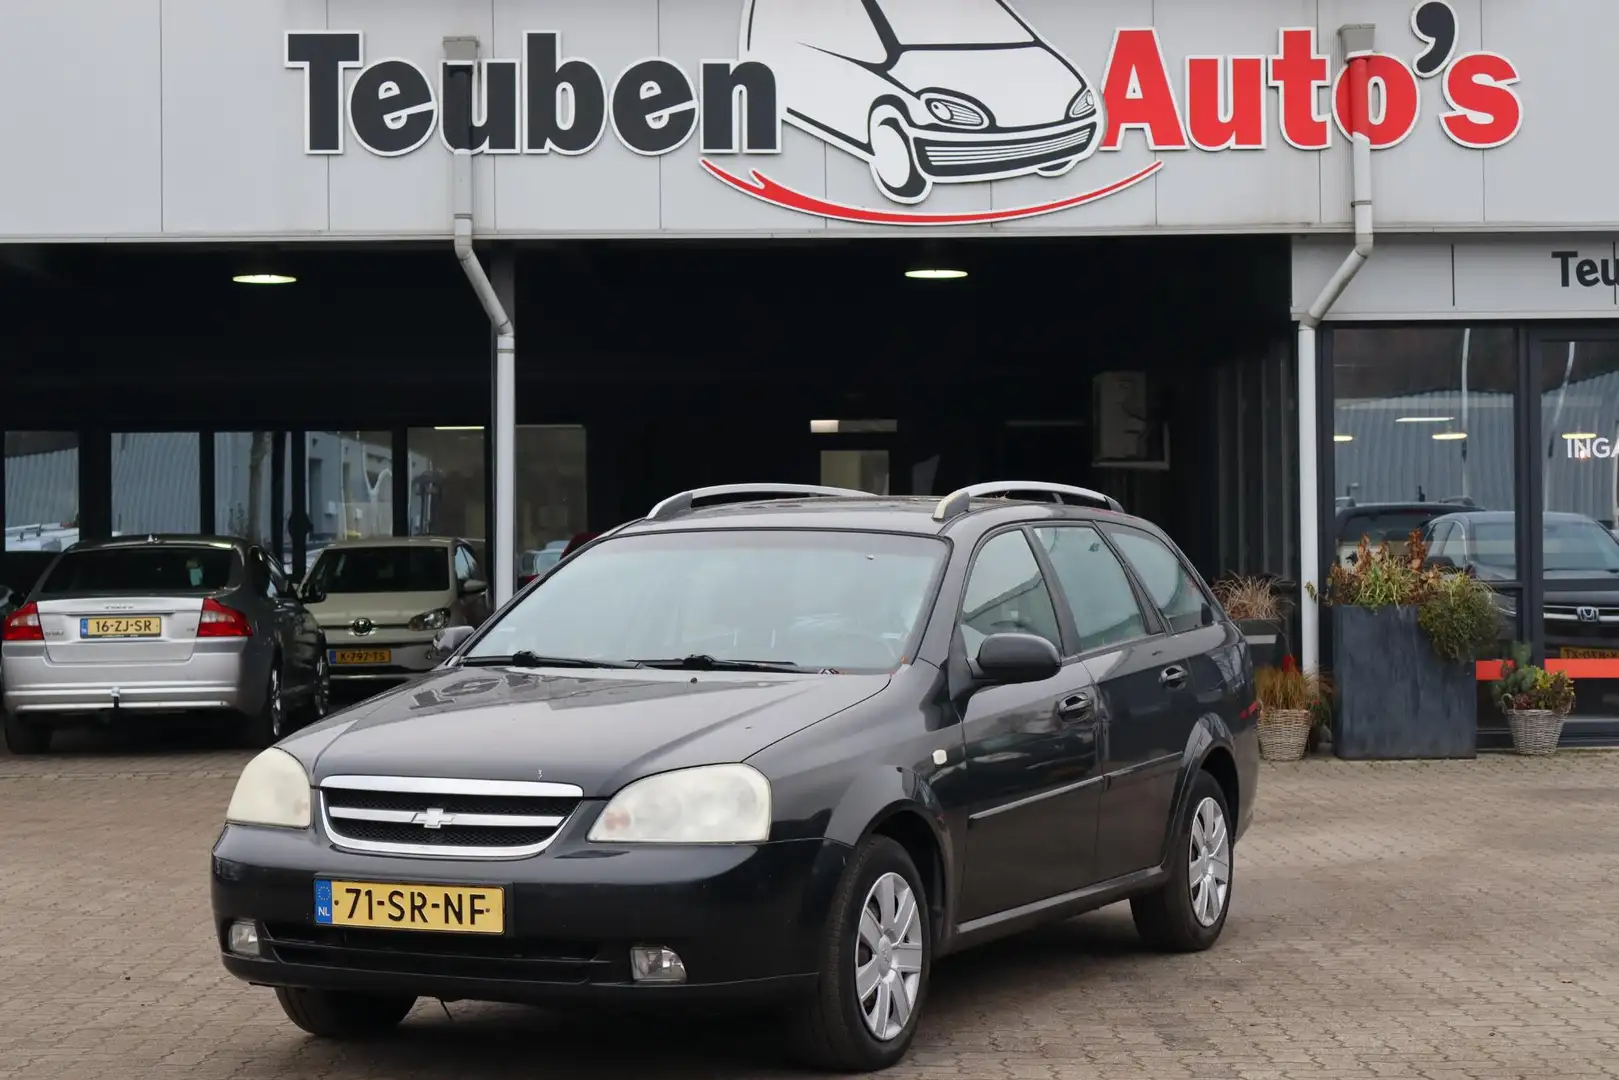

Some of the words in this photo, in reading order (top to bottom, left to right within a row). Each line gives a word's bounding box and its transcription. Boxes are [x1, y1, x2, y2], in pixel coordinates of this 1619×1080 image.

[285, 30, 782, 156] Teuben
[1100, 1, 1523, 150] Auto's
[1551, 251, 1619, 287] Teu
[95, 619, 152, 633] 16-ZJ-SR
[318, 906, 331, 917] NL
[345, 887, 486, 925] 71-SR-NF
